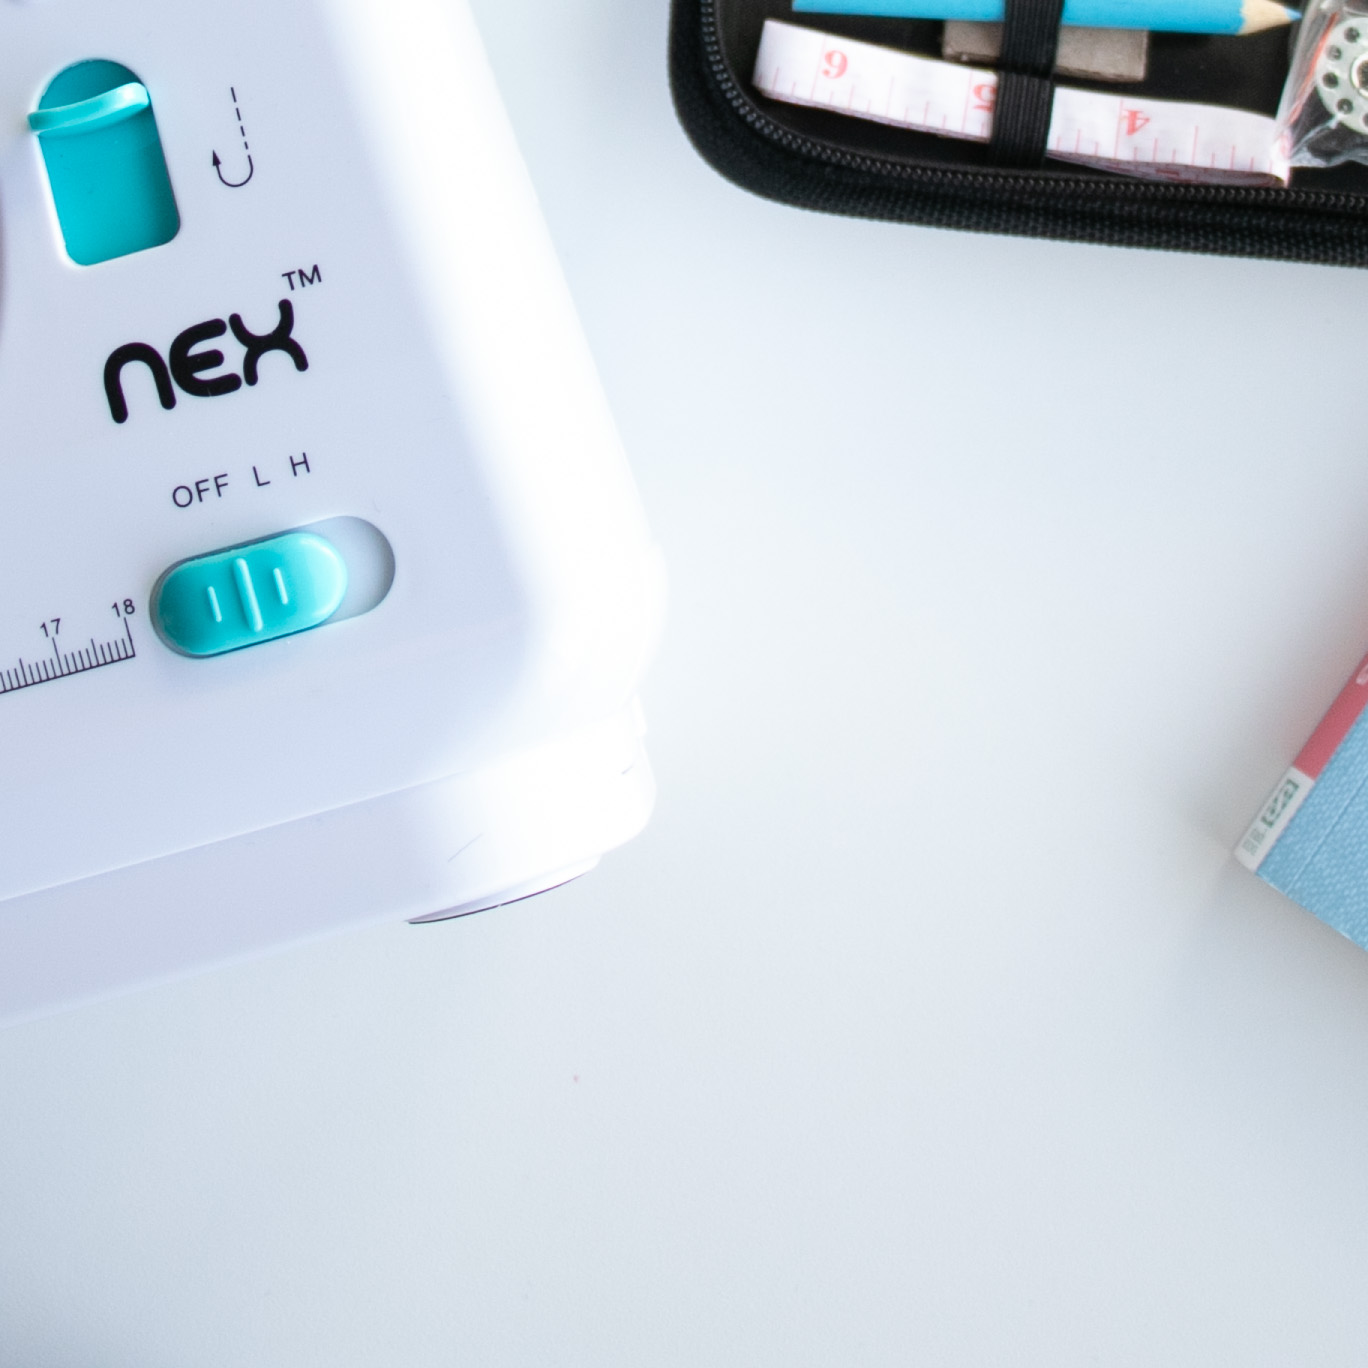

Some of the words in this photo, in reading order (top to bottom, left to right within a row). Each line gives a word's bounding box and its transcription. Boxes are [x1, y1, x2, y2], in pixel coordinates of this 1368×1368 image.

[1120, 104, 1153, 136] 4
[172, 473, 229, 508] OFF
[252, 466, 271, 487] L
[289, 452, 311, 477] H
[38, 618, 62, 638] 17
[109, 598, 135, 618] 18
